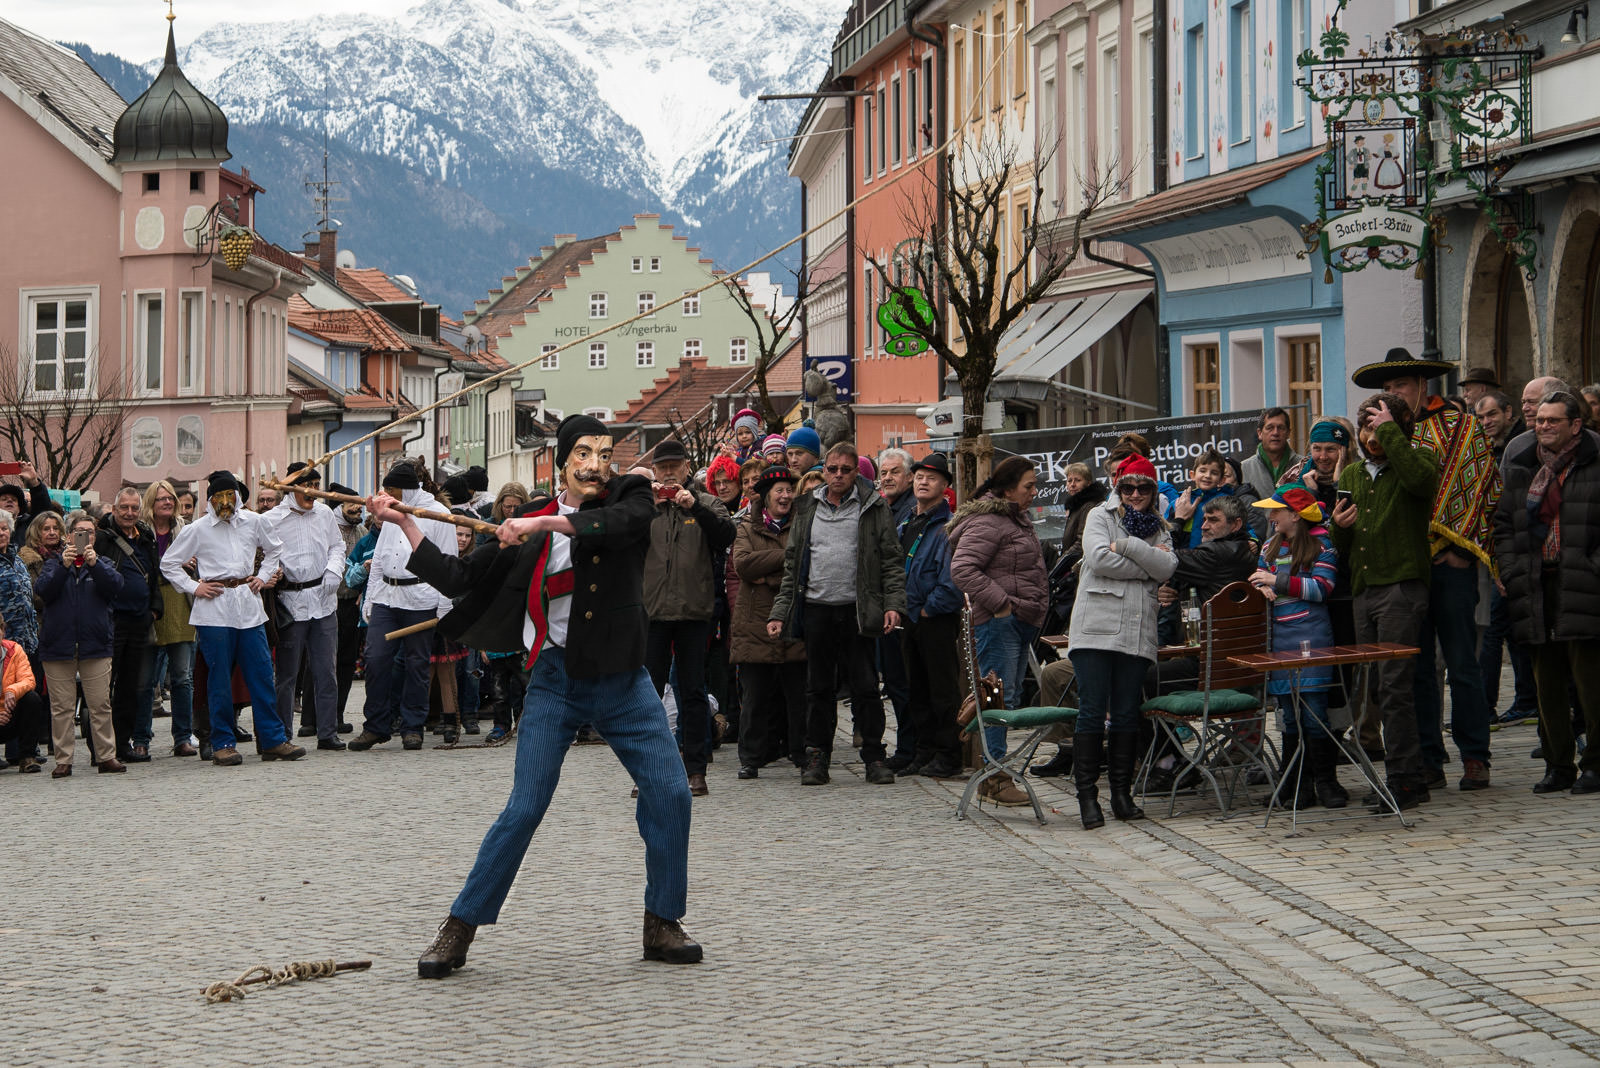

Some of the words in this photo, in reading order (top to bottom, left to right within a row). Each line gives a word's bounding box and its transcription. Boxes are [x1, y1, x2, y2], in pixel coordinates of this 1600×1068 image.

[555, 327, 592, 337] HOTEL
[617, 320, 677, 337] Angerbräu
[1155, 421, 1205, 433] Schreinermeister
[1094, 435, 1243, 467] Pettboden
